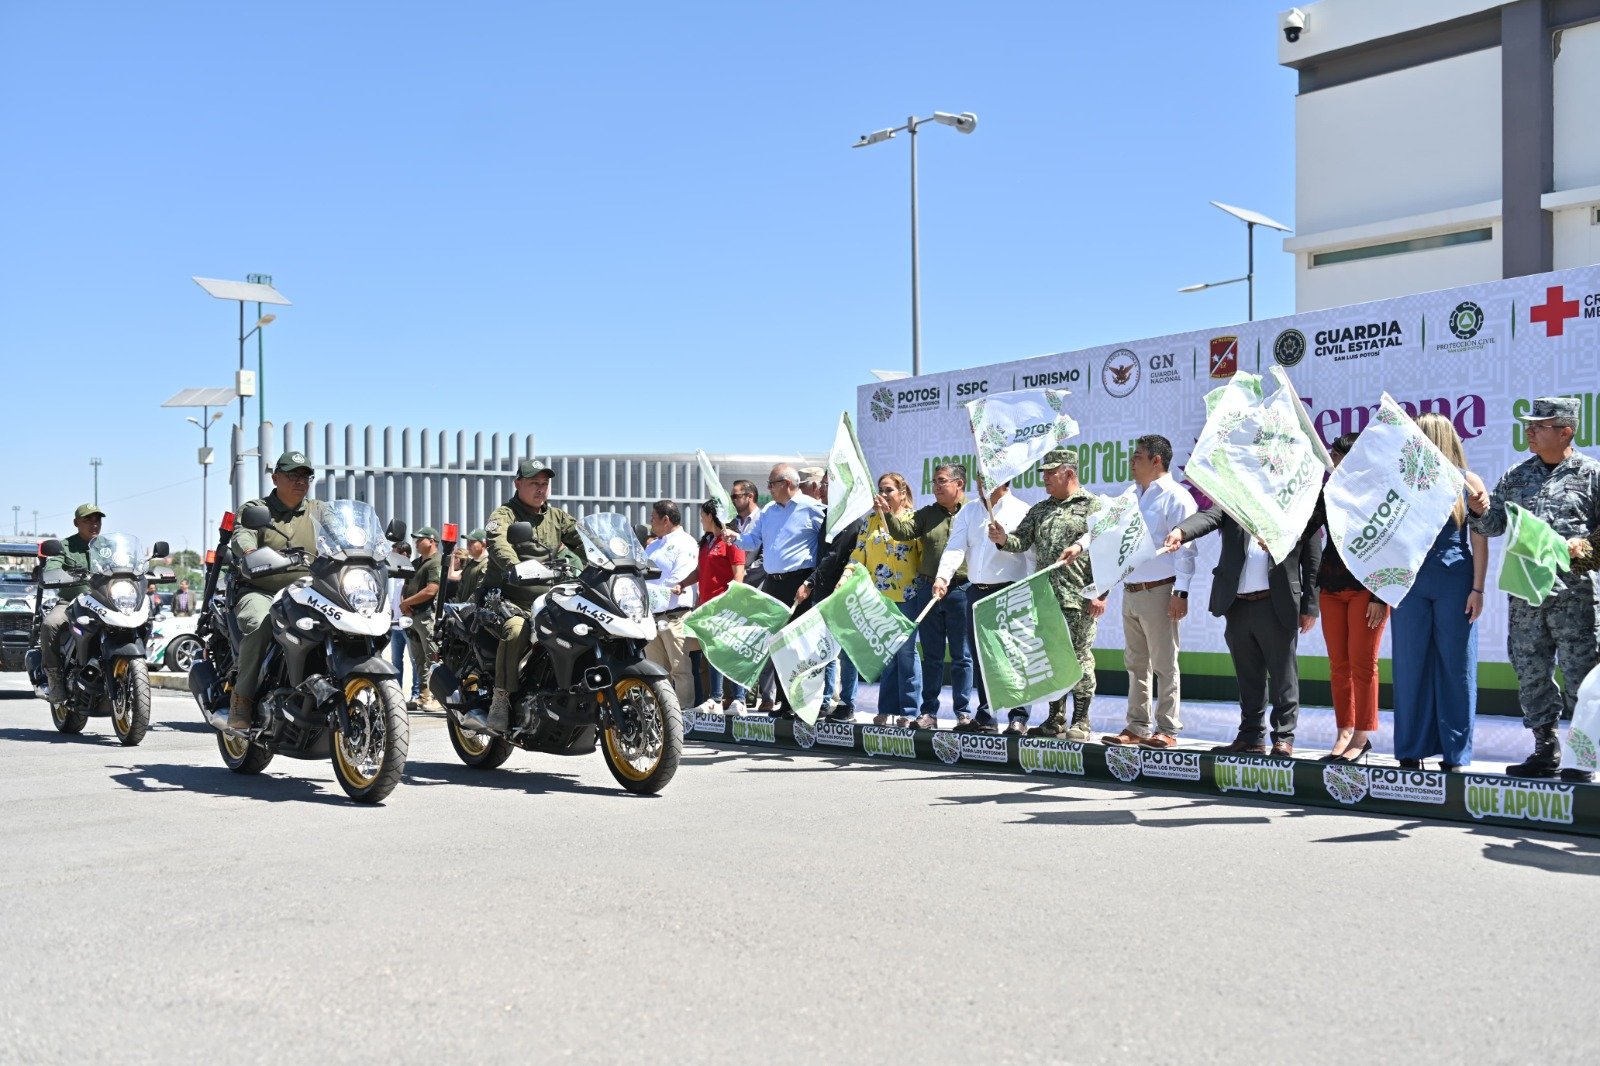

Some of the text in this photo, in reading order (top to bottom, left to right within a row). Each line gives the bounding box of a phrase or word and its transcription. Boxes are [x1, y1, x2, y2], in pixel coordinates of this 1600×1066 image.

[1315, 320, 1402, 346] GUARDIA
[1314, 344, 1346, 357] CIVIL
[1348, 336, 1403, 353] ESTATAL
[1436, 337, 1496, 351] PROTECCIÓN CIVIL
[1149, 353, 1175, 371] GN
[1346, 353, 1359, 361] LUIS
[1022, 368, 1081, 388] TURISMO
[1150, 369, 1179, 379] GUARDIA
[1150, 375, 1182, 385] NACIONAL
[956, 380, 989, 397] SSPC
[84, 600, 108, 619] M-462
[307, 595, 343, 621] M-456
[576, 602, 614, 625] M-457
[864, 734, 881, 755] QUE
[881, 738, 914, 757] APOYA!
[1020, 747, 1082, 773] QUE APOYA!
[1168, 766, 1199, 774] POTOSINOS
[1215, 764, 1293, 793] QUE APOYA!
[1372, 783, 1443, 797] PARA LOS POTOSINOS
[1467, 785, 1571, 821] QUE APOYA!
